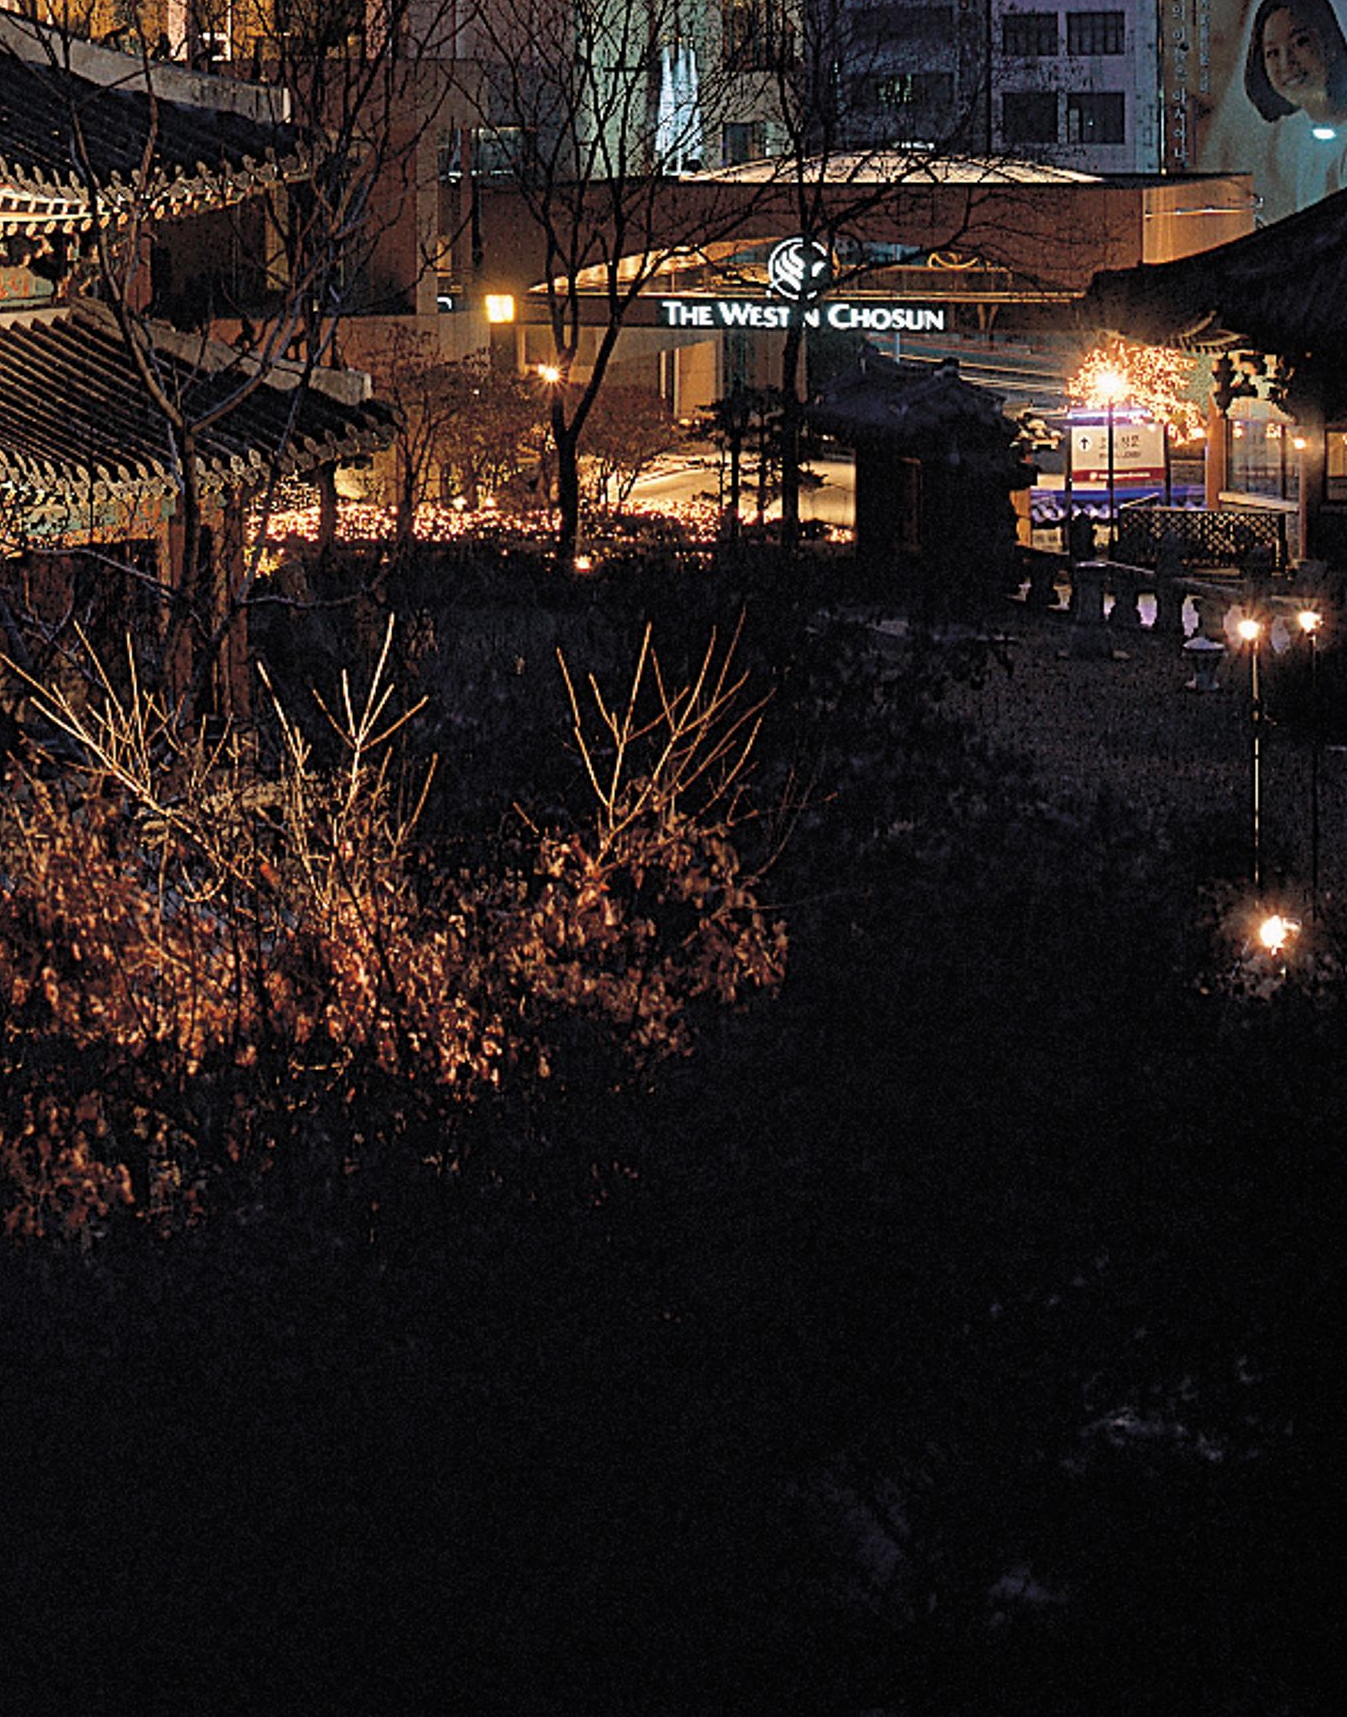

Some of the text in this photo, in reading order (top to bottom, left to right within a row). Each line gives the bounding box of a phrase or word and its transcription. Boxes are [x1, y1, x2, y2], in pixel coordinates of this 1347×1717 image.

[662, 300, 945, 331] THE WESTN CHOSUN
